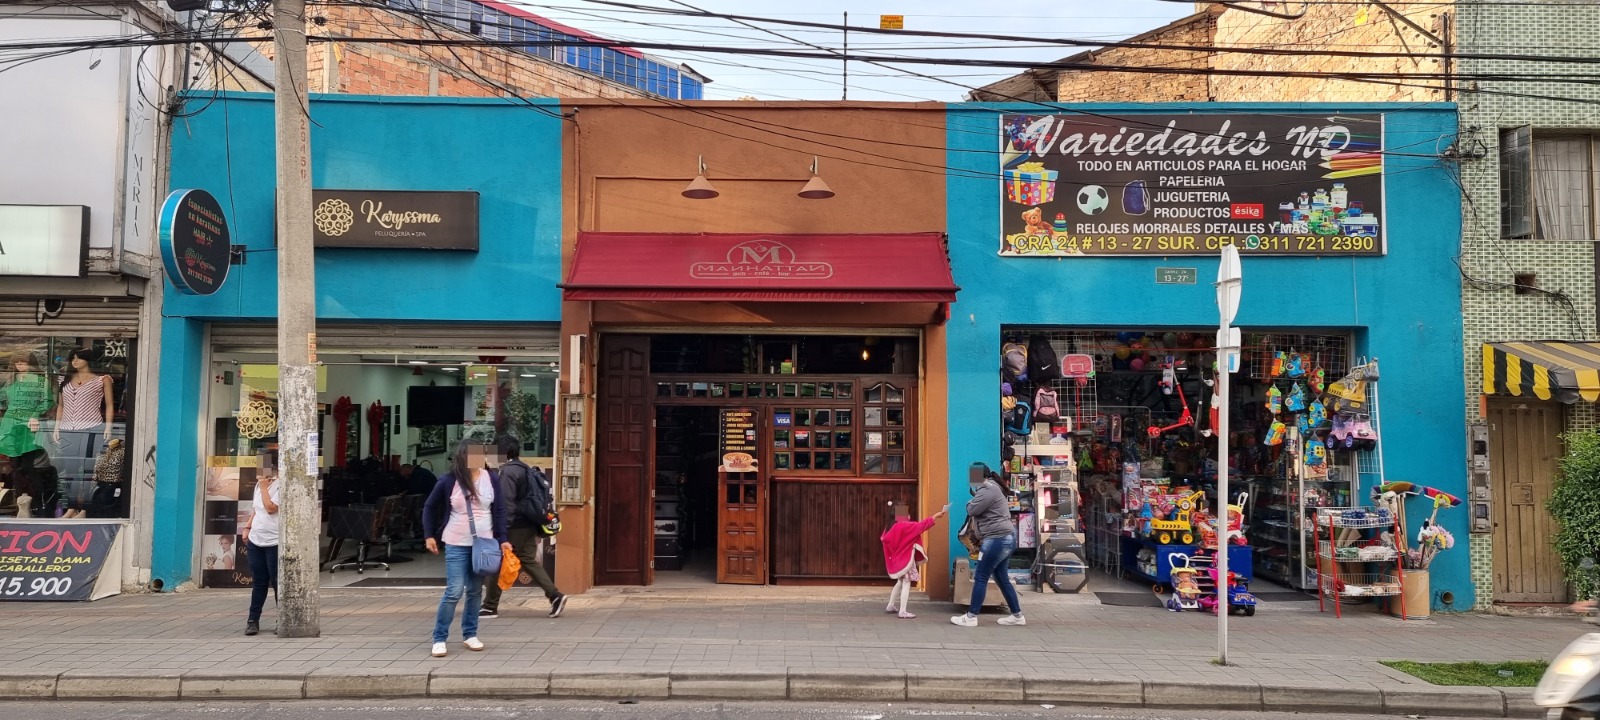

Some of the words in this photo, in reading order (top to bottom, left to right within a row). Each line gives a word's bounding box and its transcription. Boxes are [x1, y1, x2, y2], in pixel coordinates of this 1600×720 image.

[1023, 115, 1270, 158] Variedades
[1077, 160, 1112, 171] TODO
[1117, 160, 1131, 171] EN
[1135, 160, 1205, 171] ARTICULOS
[1209, 160, 1242, 171] PARA
[1245, 160, 1259, 171] EL
[1262, 160, 1307, 171] HOGAR
[1159, 176, 1225, 187] PAPELERIA
[1153, 191, 1230, 203] JUGUETERIA
[361, 200, 441, 230] Karyssma
[1153, 207, 1230, 218] PRODUCTOS
[1234, 206, 1260, 217] ésika
[1076, 223, 1129, 234] RELOJES
[1133, 223, 1201, 234] MORRALES
[1205, 223, 1265, 234] DETALLES
[1268, 223, 1276, 234] Y
[1280, 223, 1308, 234] MAS
[1015, 236, 1053, 250] CRA
[1057, 236, 1078, 250] 24
[1082, 236, 1093, 250] #
[1097, 236, 1117, 250] 13
[1132, 236, 1153, 250] 27
[1157, 236, 1200, 250] SUR.
[1259, 236, 1289, 250] 311
[1296, 236, 1325, 250] 721
[1331, 236, 1373, 250] 2390
[738, 246, 784, 264] M
[53, 556, 91, 564] DAMA
